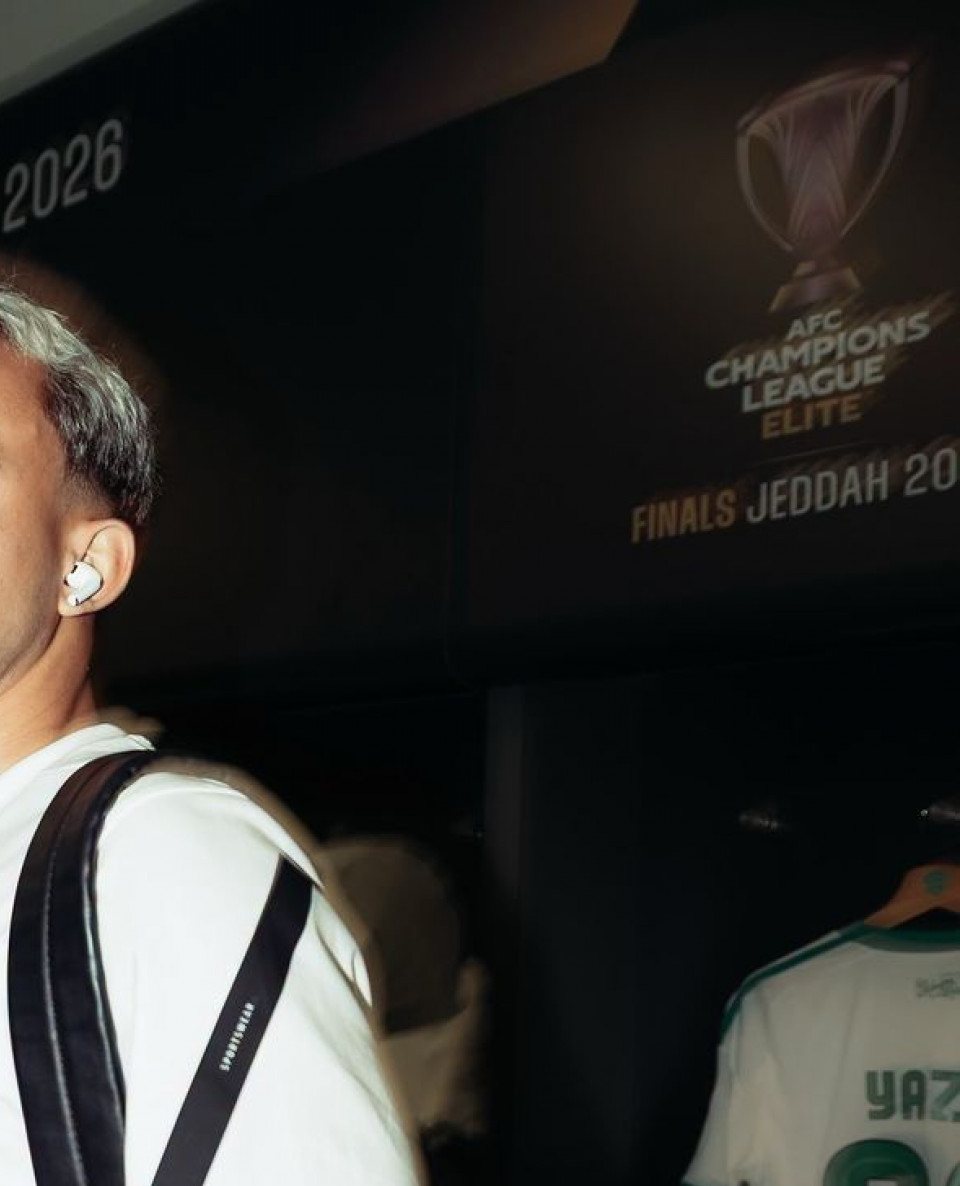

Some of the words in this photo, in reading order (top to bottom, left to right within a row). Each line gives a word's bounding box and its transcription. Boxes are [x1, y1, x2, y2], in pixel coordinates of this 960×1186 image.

[2, 117, 124, 234] 2026
[704, 310, 931, 389] CHAMPIONS
[785, 308, 843, 340] AFC
[741, 354, 886, 413] LEAGUE
[761, 395, 863, 440] ELITE
[630, 488, 737, 544] FINALS
[745, 458, 890, 525] JEDDAH
